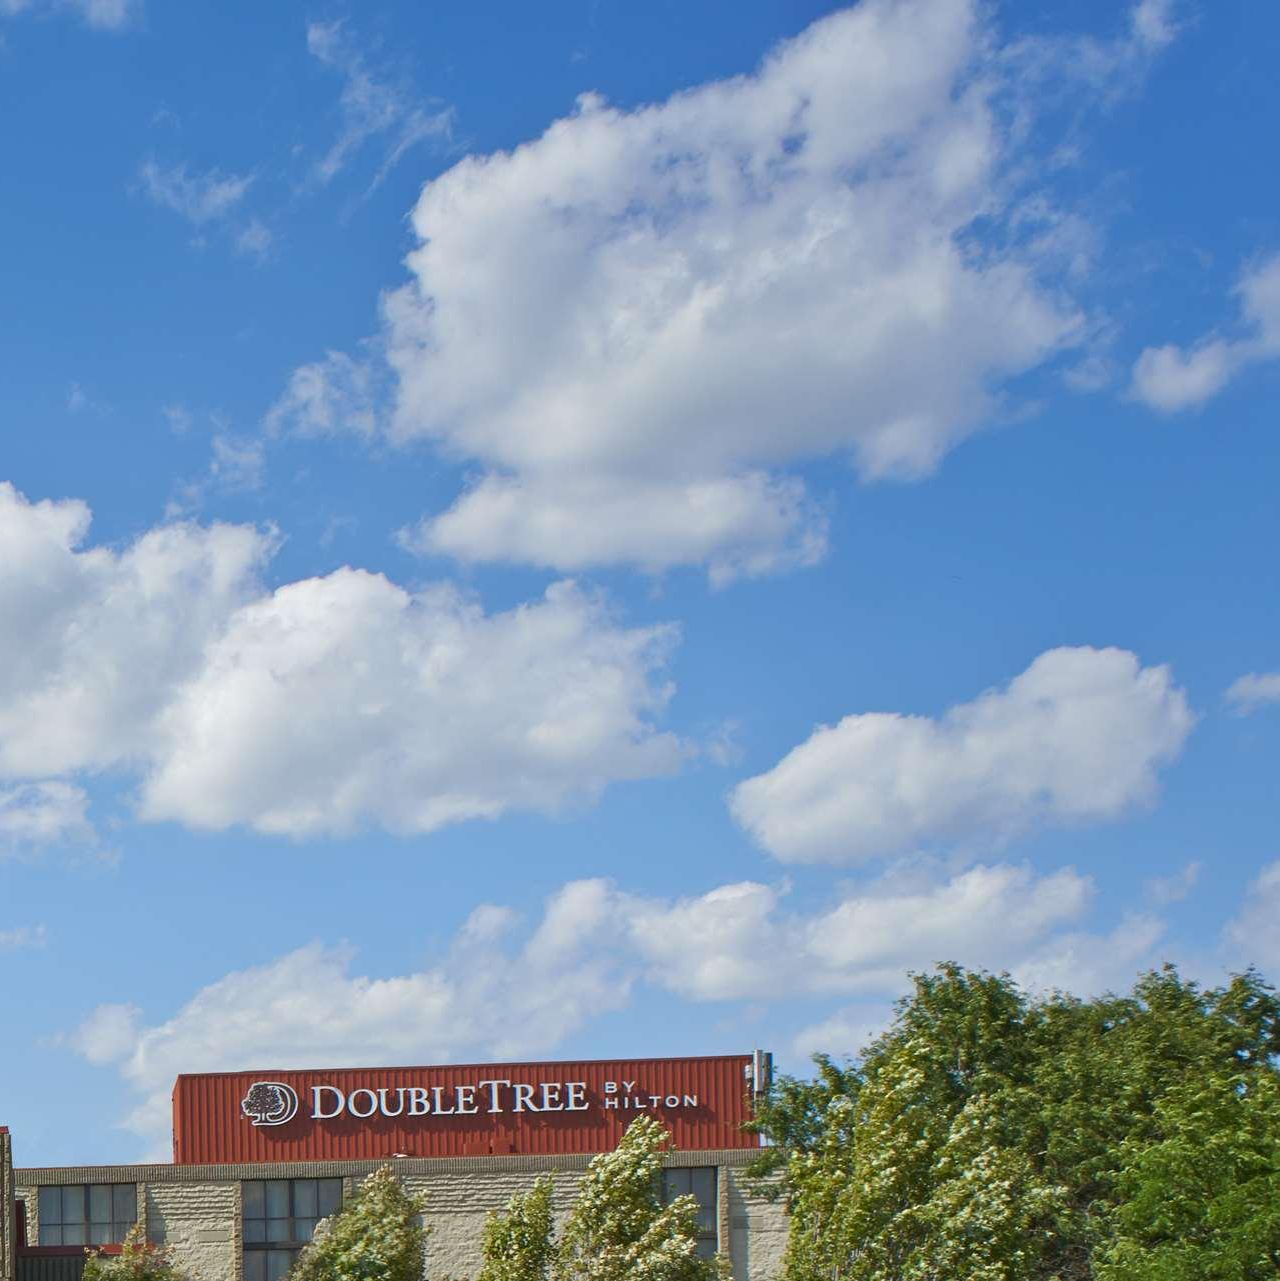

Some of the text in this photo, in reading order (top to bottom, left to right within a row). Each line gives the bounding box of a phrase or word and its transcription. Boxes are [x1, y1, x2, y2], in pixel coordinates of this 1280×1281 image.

[604, 1081, 636, 1094] BY
[310, 1080, 590, 1119] DOUBLETREE
[604, 1094, 699, 1110] HILTON
